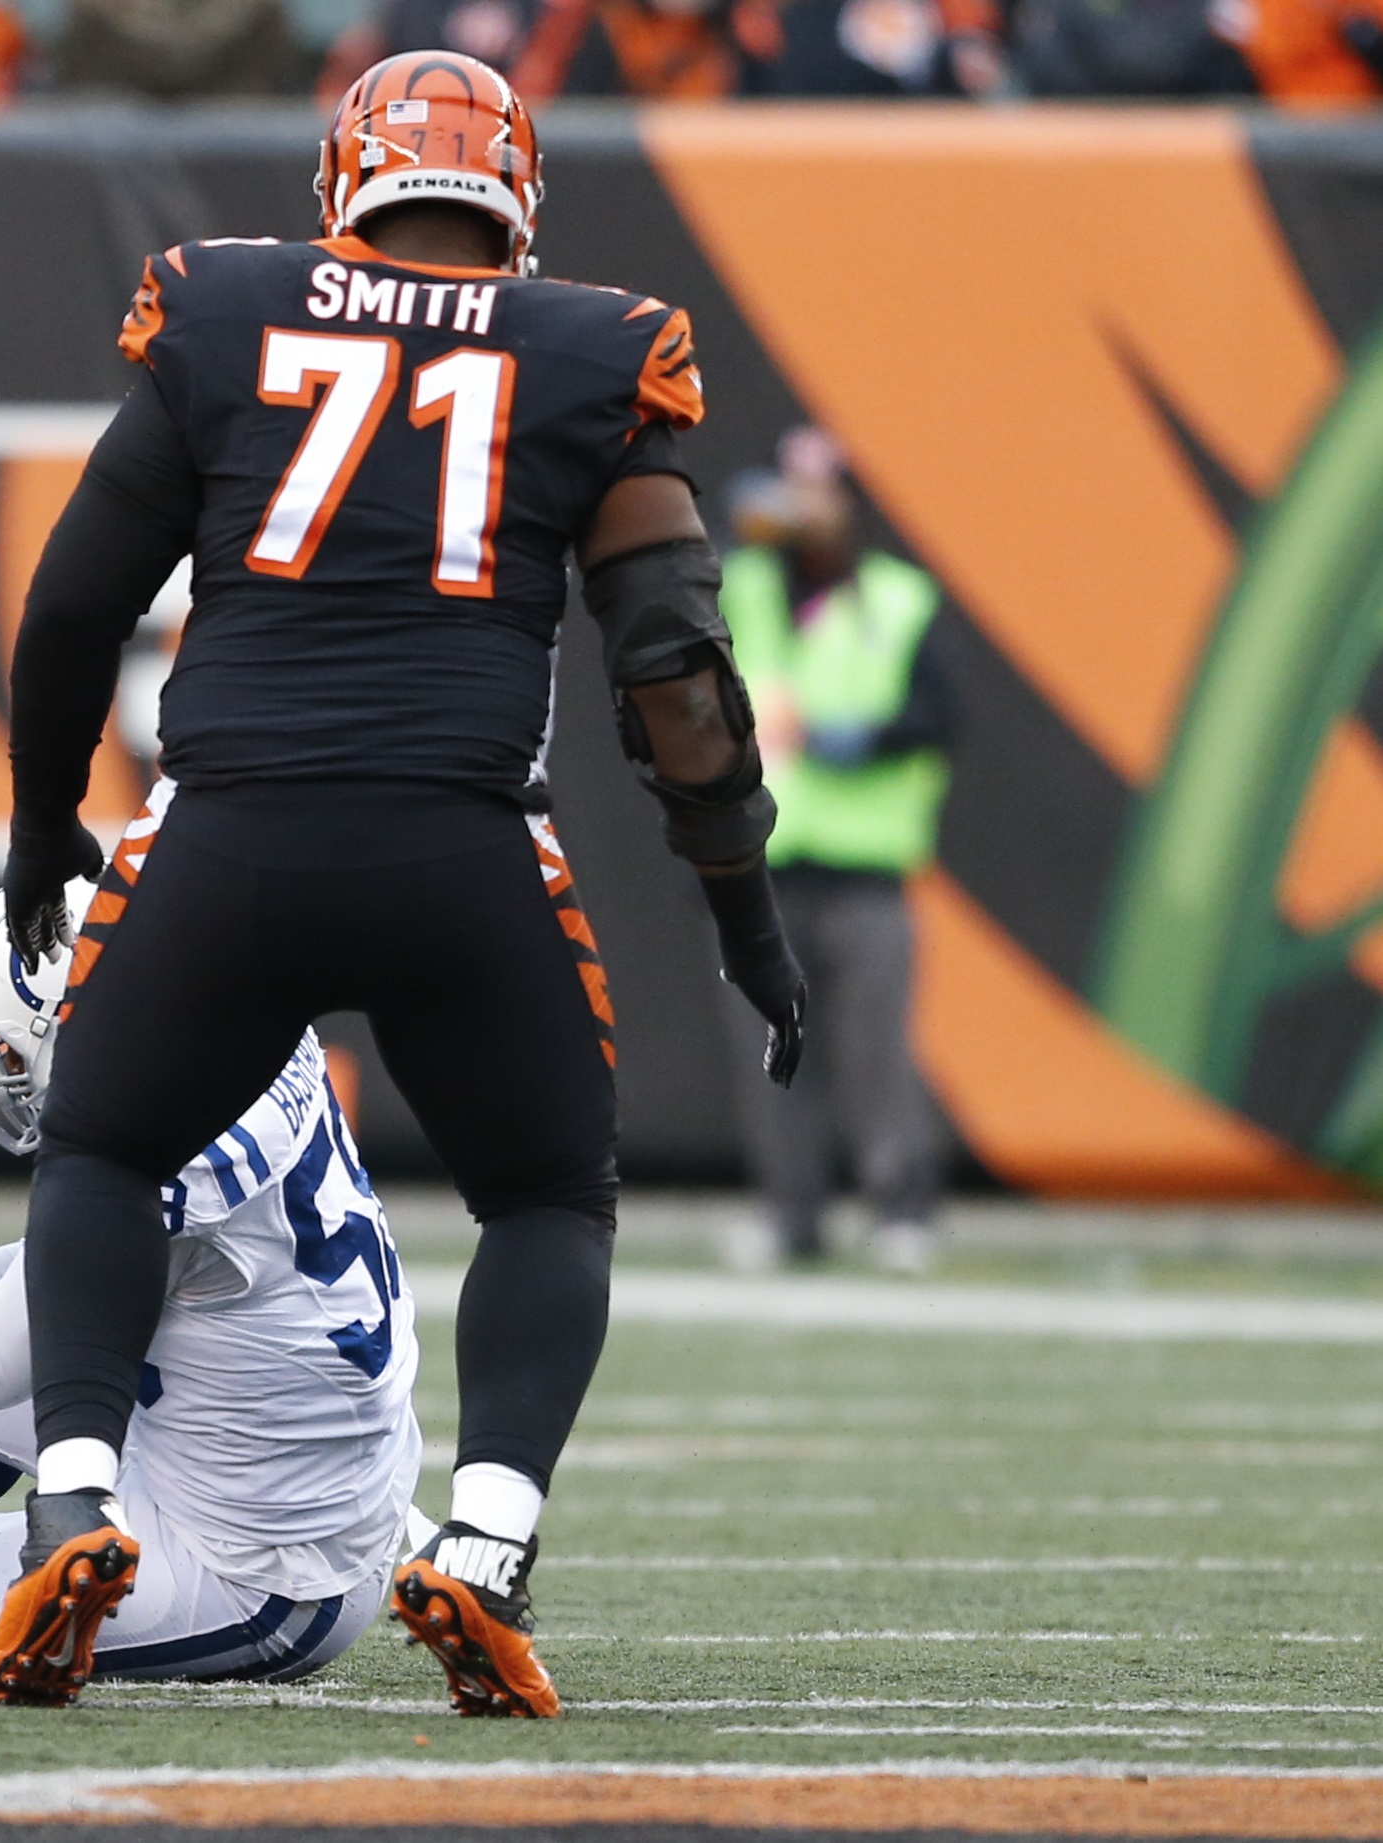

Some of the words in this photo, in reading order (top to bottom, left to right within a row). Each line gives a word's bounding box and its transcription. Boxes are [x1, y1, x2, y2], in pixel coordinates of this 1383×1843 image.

[398, 179, 487, 194] BENGALS
[306, 260, 497, 336] SMITH
[244, 326, 517, 599] 71
[433, 1535, 526, 1599] NIKE
